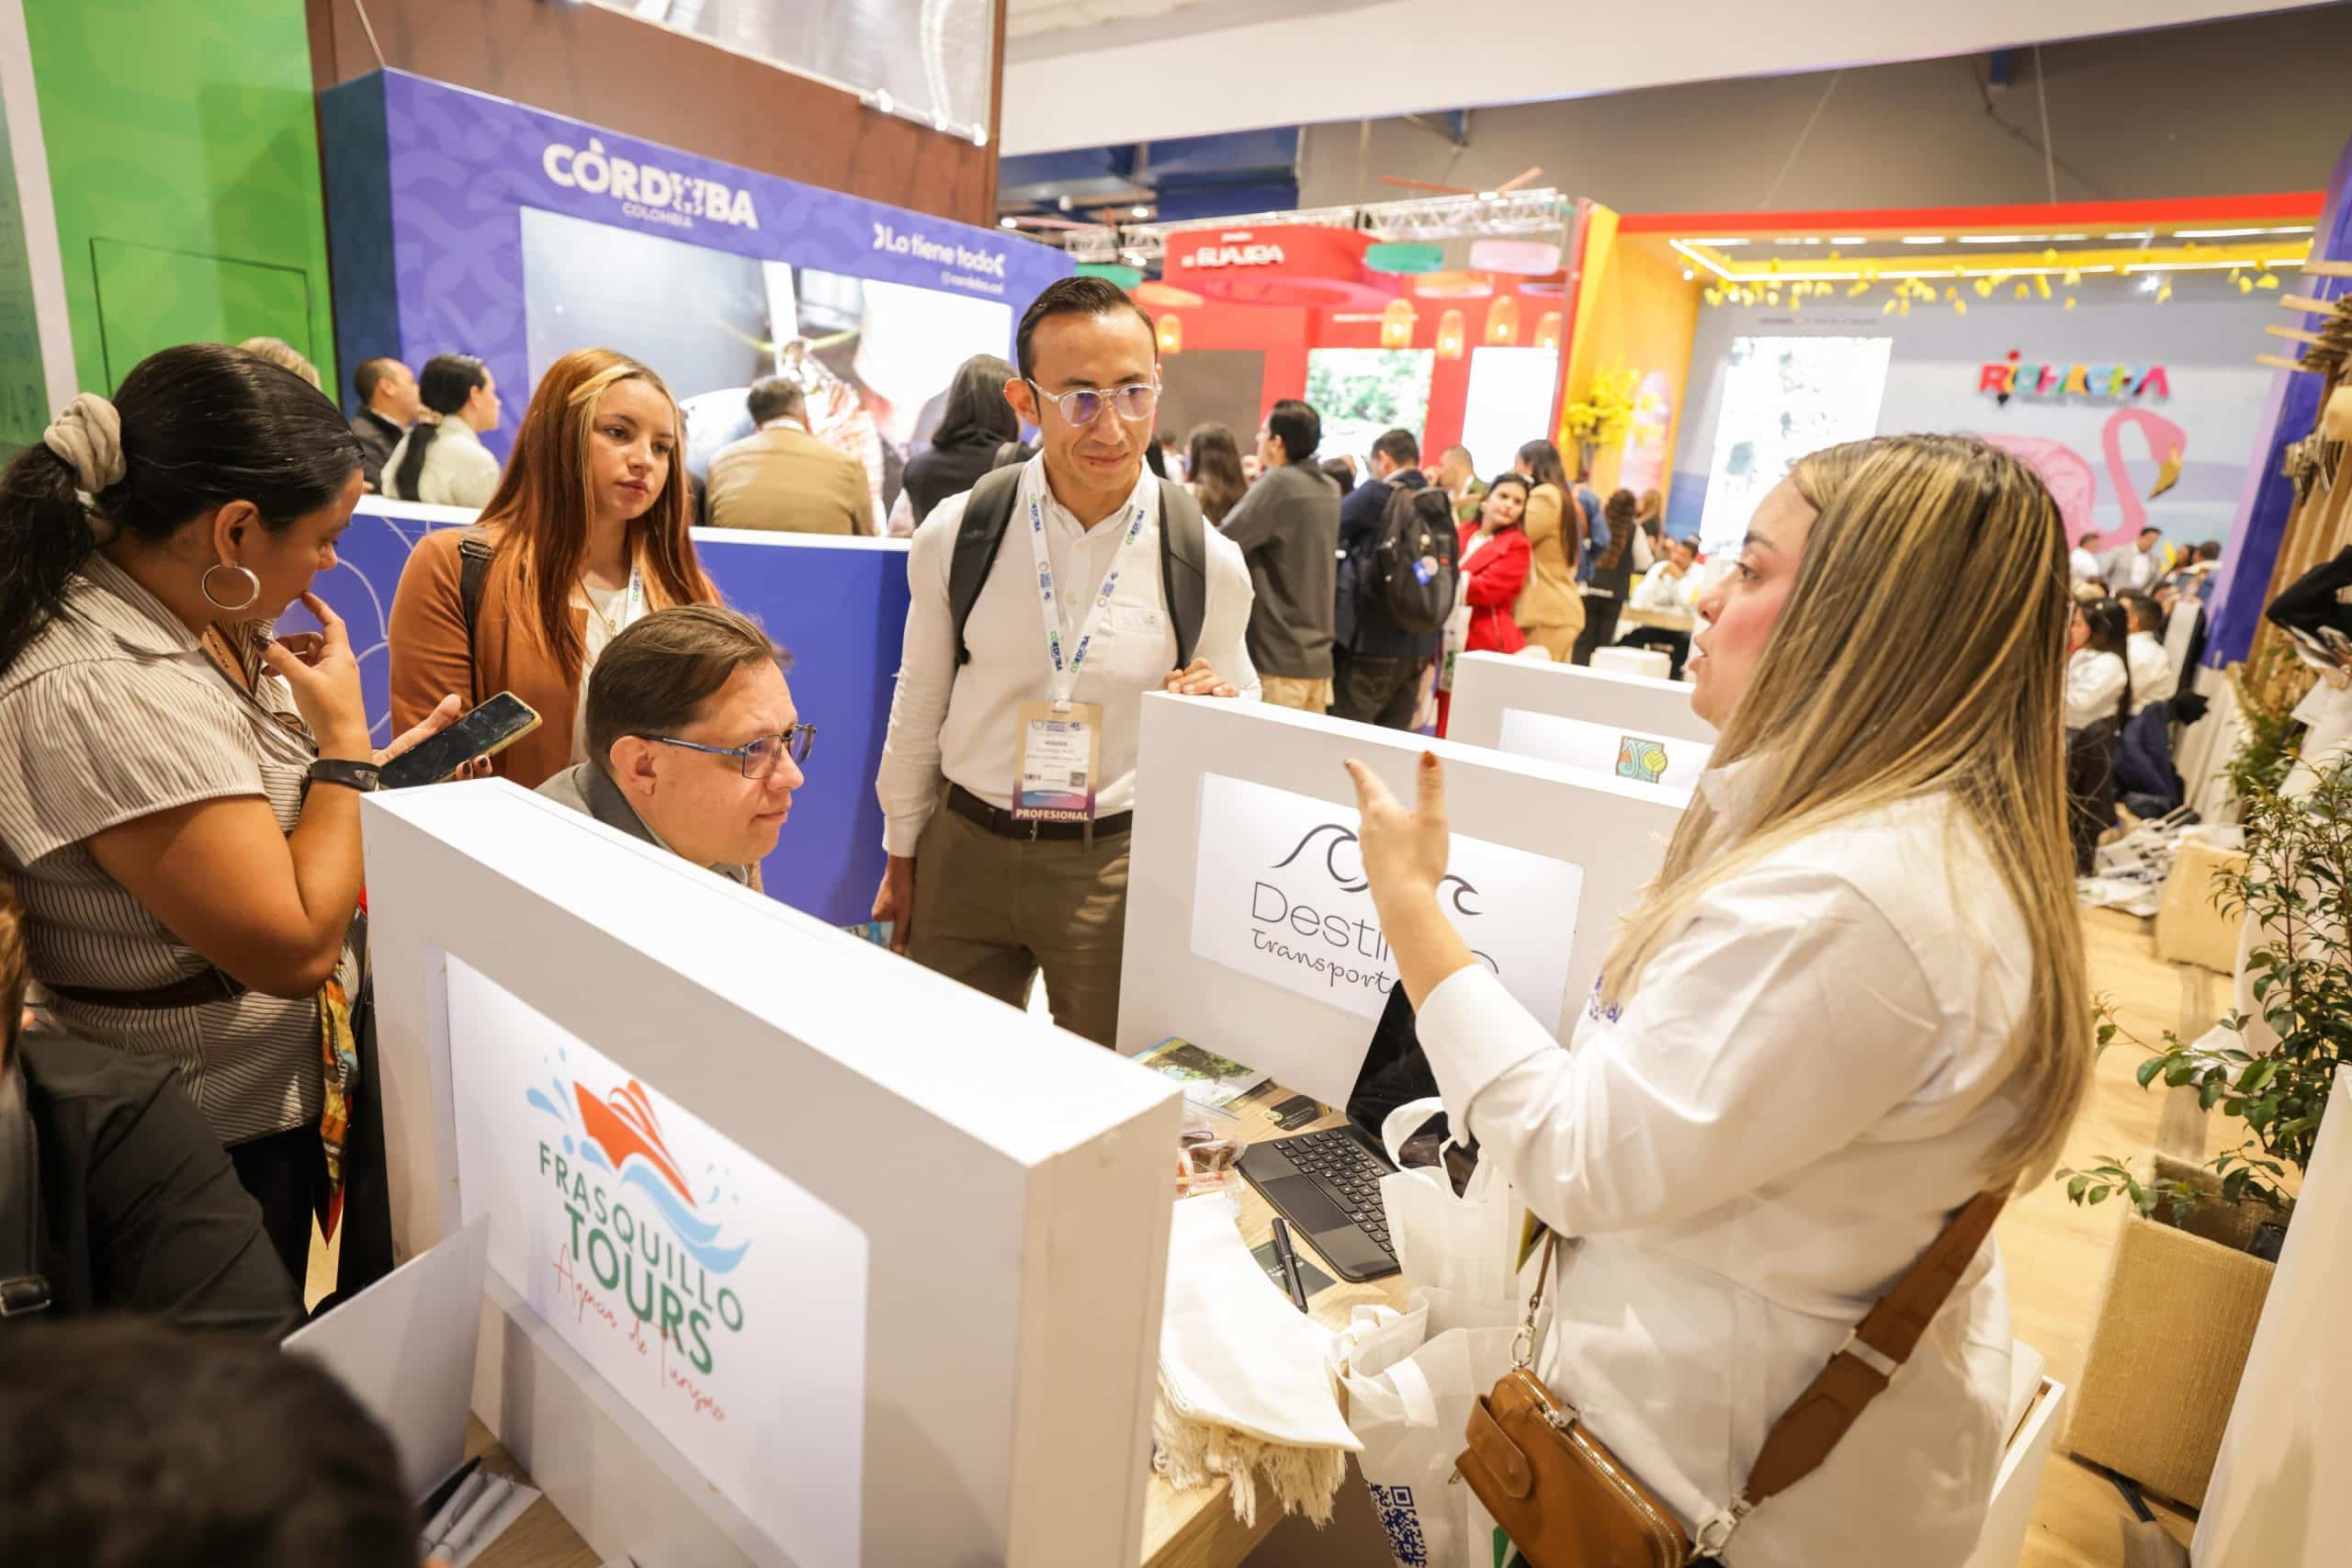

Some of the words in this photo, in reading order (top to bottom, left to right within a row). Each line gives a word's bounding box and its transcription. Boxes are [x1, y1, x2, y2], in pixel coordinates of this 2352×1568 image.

[886, 226, 910, 254] Lo
[911, 233, 955, 265] tiene
[956, 244, 994, 274] todo
[1015, 808, 1091, 821] PROFESIONAL
[1250, 928, 1393, 995] Transport
[539, 1140, 743, 1333] FRASQUILLO
[564, 1201, 713, 1376] TOURS
